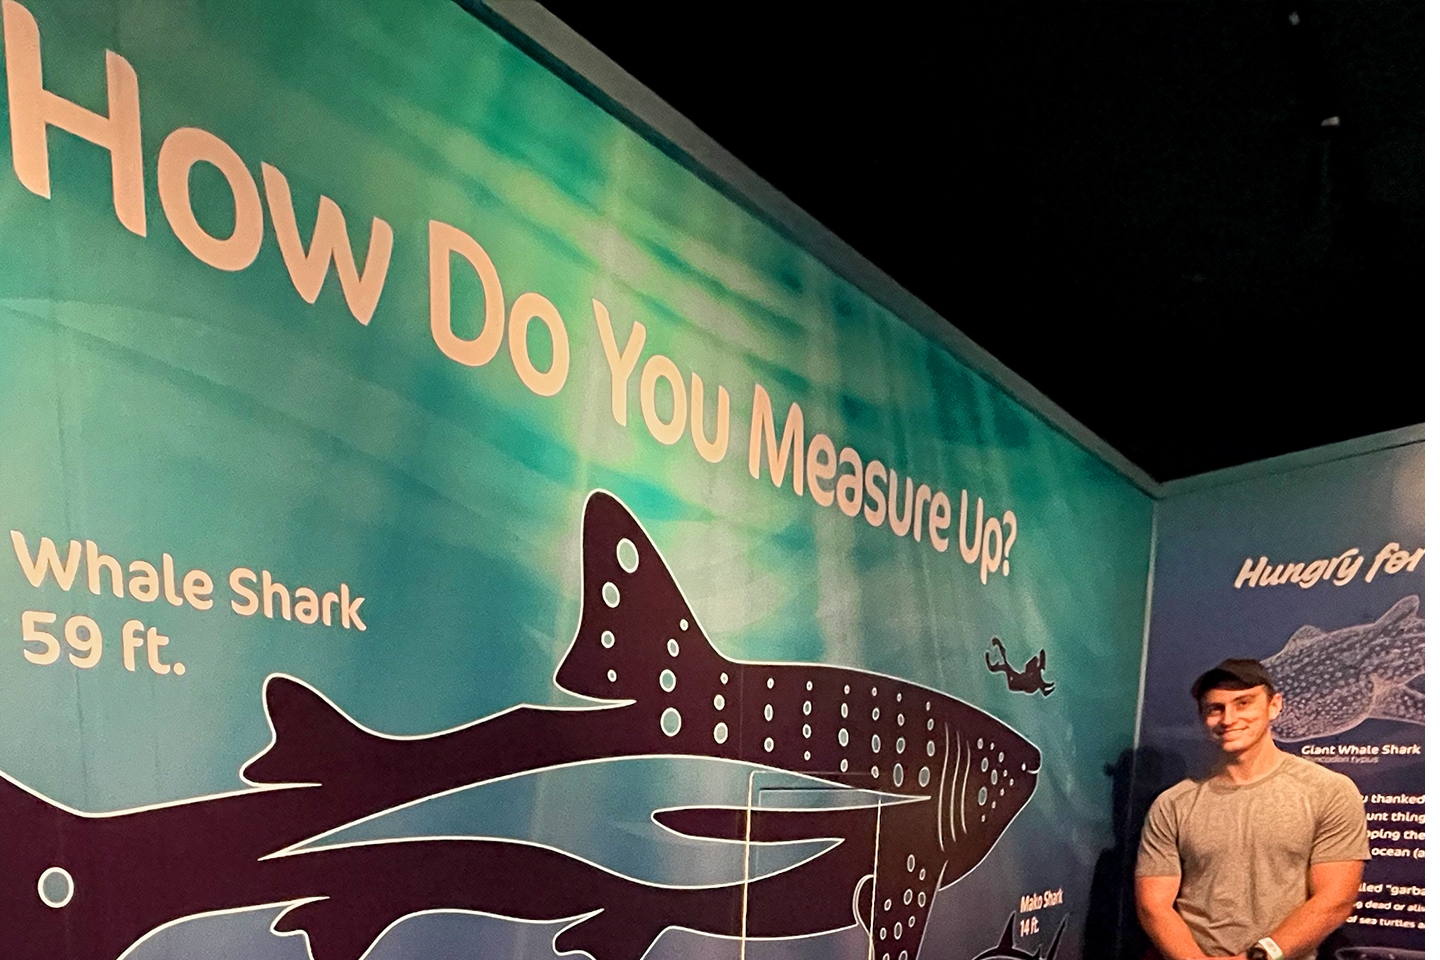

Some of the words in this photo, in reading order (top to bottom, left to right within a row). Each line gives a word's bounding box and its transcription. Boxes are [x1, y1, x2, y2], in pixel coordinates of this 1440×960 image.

[2, 0, 394, 326] How
[428, 219, 570, 396] Do
[592, 298, 730, 463] You
[748, 383, 951, 552] Measure
[959, 489, 1017, 585] Up?
[1234, 548, 1364, 589] Hungry
[10, 530, 214, 610] Whale
[229, 567, 367, 631] Shark
[21, 610, 103, 669] 59
[122, 619, 186, 676] ft.
[1301, 744, 1336, 755] Giant
[1337, 744, 1380, 755] Whale
[1381, 743, 1421, 755] Shark
[1371, 794, 1425, 804] thanked
[1371, 847, 1410, 857] ocean
[1020, 893, 1043, 913] Mako
[1043, 888, 1063, 908] Shark
[1365, 900, 1391, 910] dead
[1393, 903, 1406, 911] or
[1020, 919, 1030, 937] 14
[1359, 917, 1378, 925] sea
[1379, 918, 1415, 928] turtles
